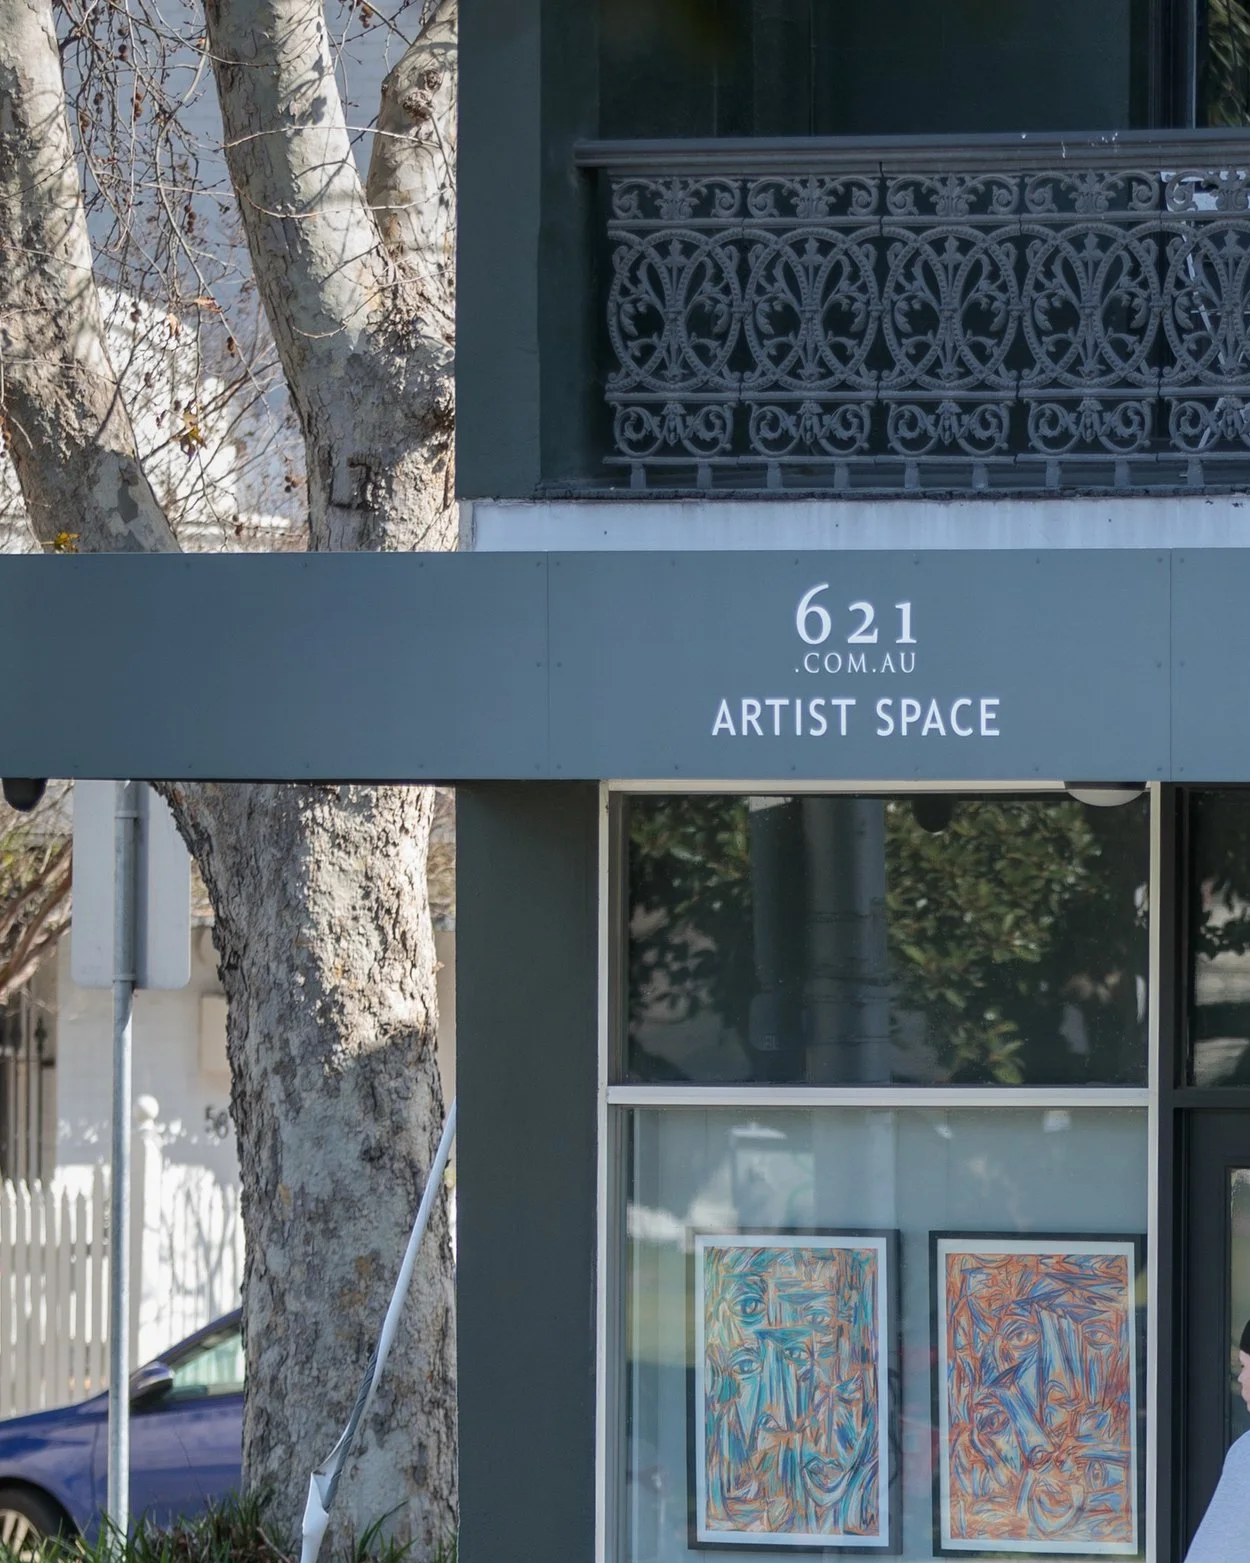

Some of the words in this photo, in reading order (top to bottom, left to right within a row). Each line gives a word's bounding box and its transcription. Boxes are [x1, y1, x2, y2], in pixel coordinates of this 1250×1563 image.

[796, 583, 917, 644] 621
[795, 652, 916, 673] .COM.AU
[712, 698, 856, 736] ARTIST
[876, 698, 1000, 736] SPACE
